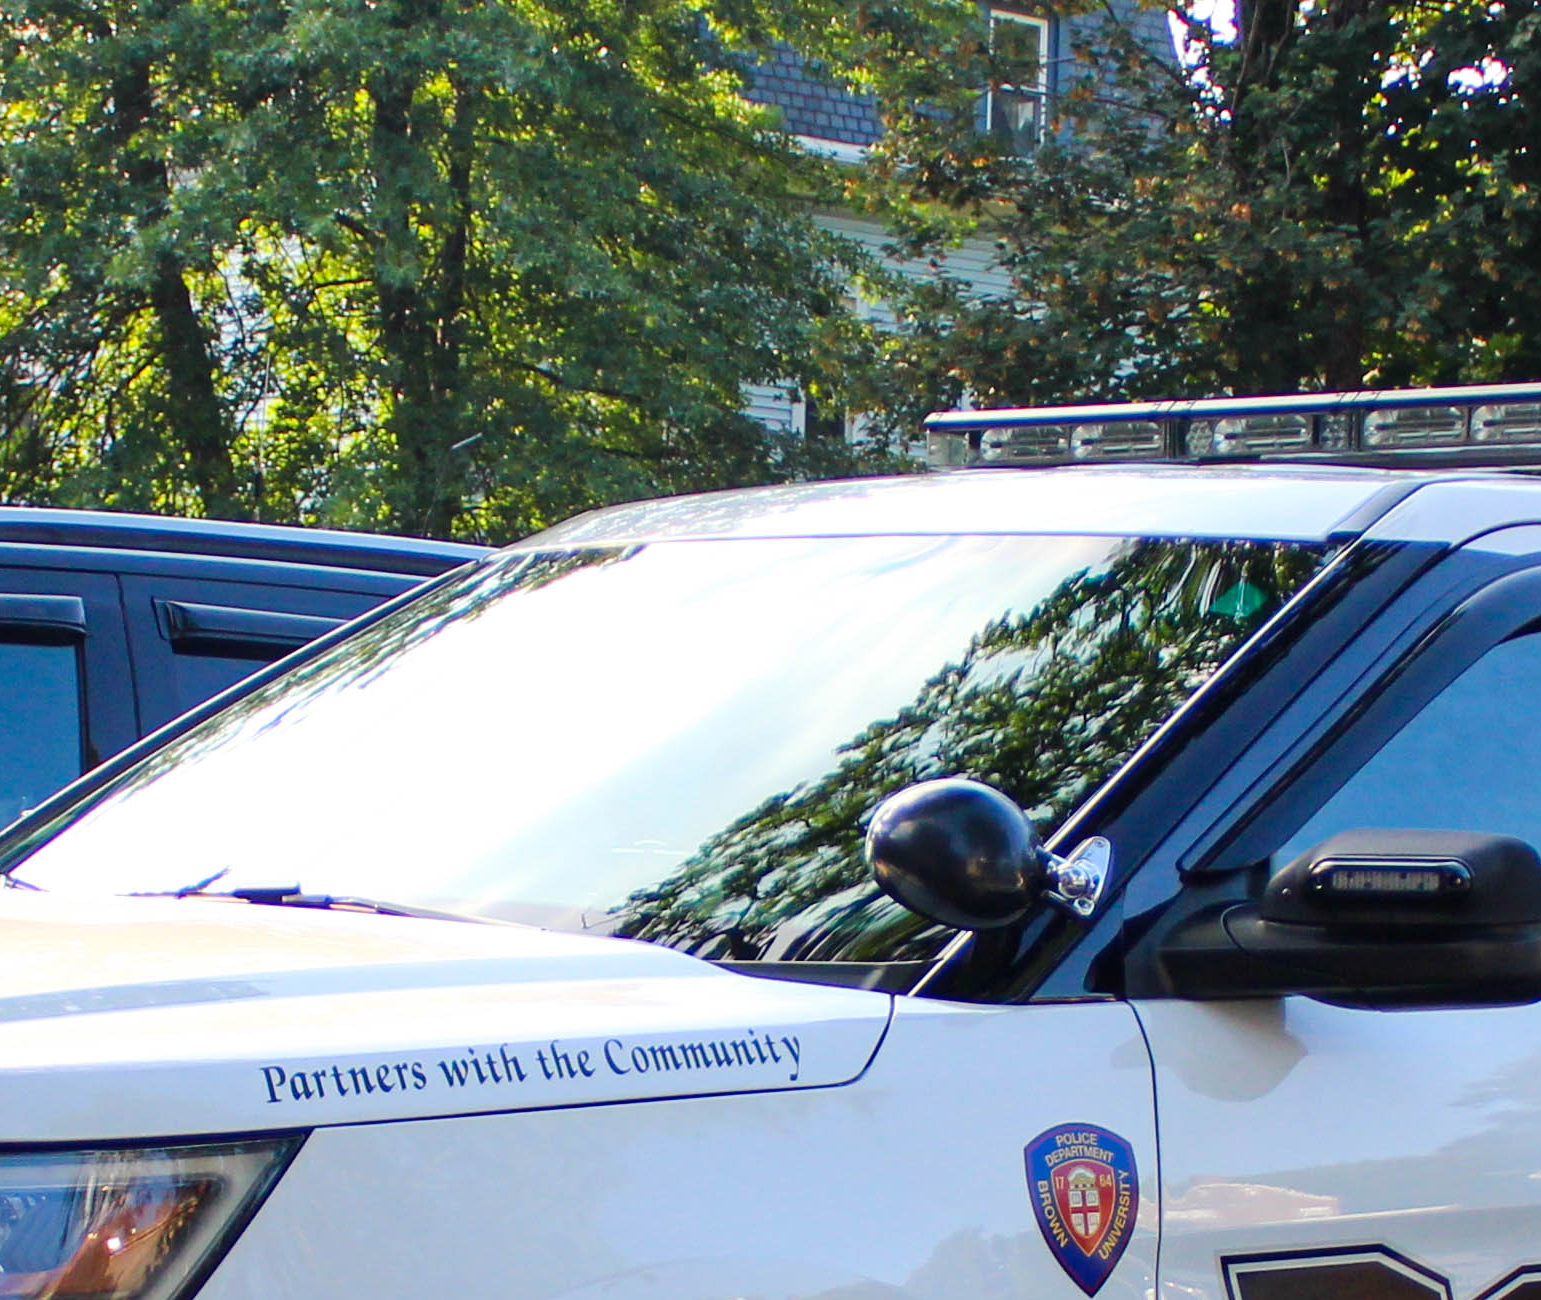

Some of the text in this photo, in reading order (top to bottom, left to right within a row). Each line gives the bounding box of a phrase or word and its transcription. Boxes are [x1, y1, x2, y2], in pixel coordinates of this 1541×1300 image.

[260, 1028, 802, 1104] Partners with the Community
[1044, 1146, 1115, 1166] DEPARTMENT
[1056, 1132, 1099, 1147] POLICE
[1055, 1175, 1065, 1190] 17
[1037, 1179, 1069, 1248] BROWN
[1097, 1168, 1131, 1261] UNIVERSITY
